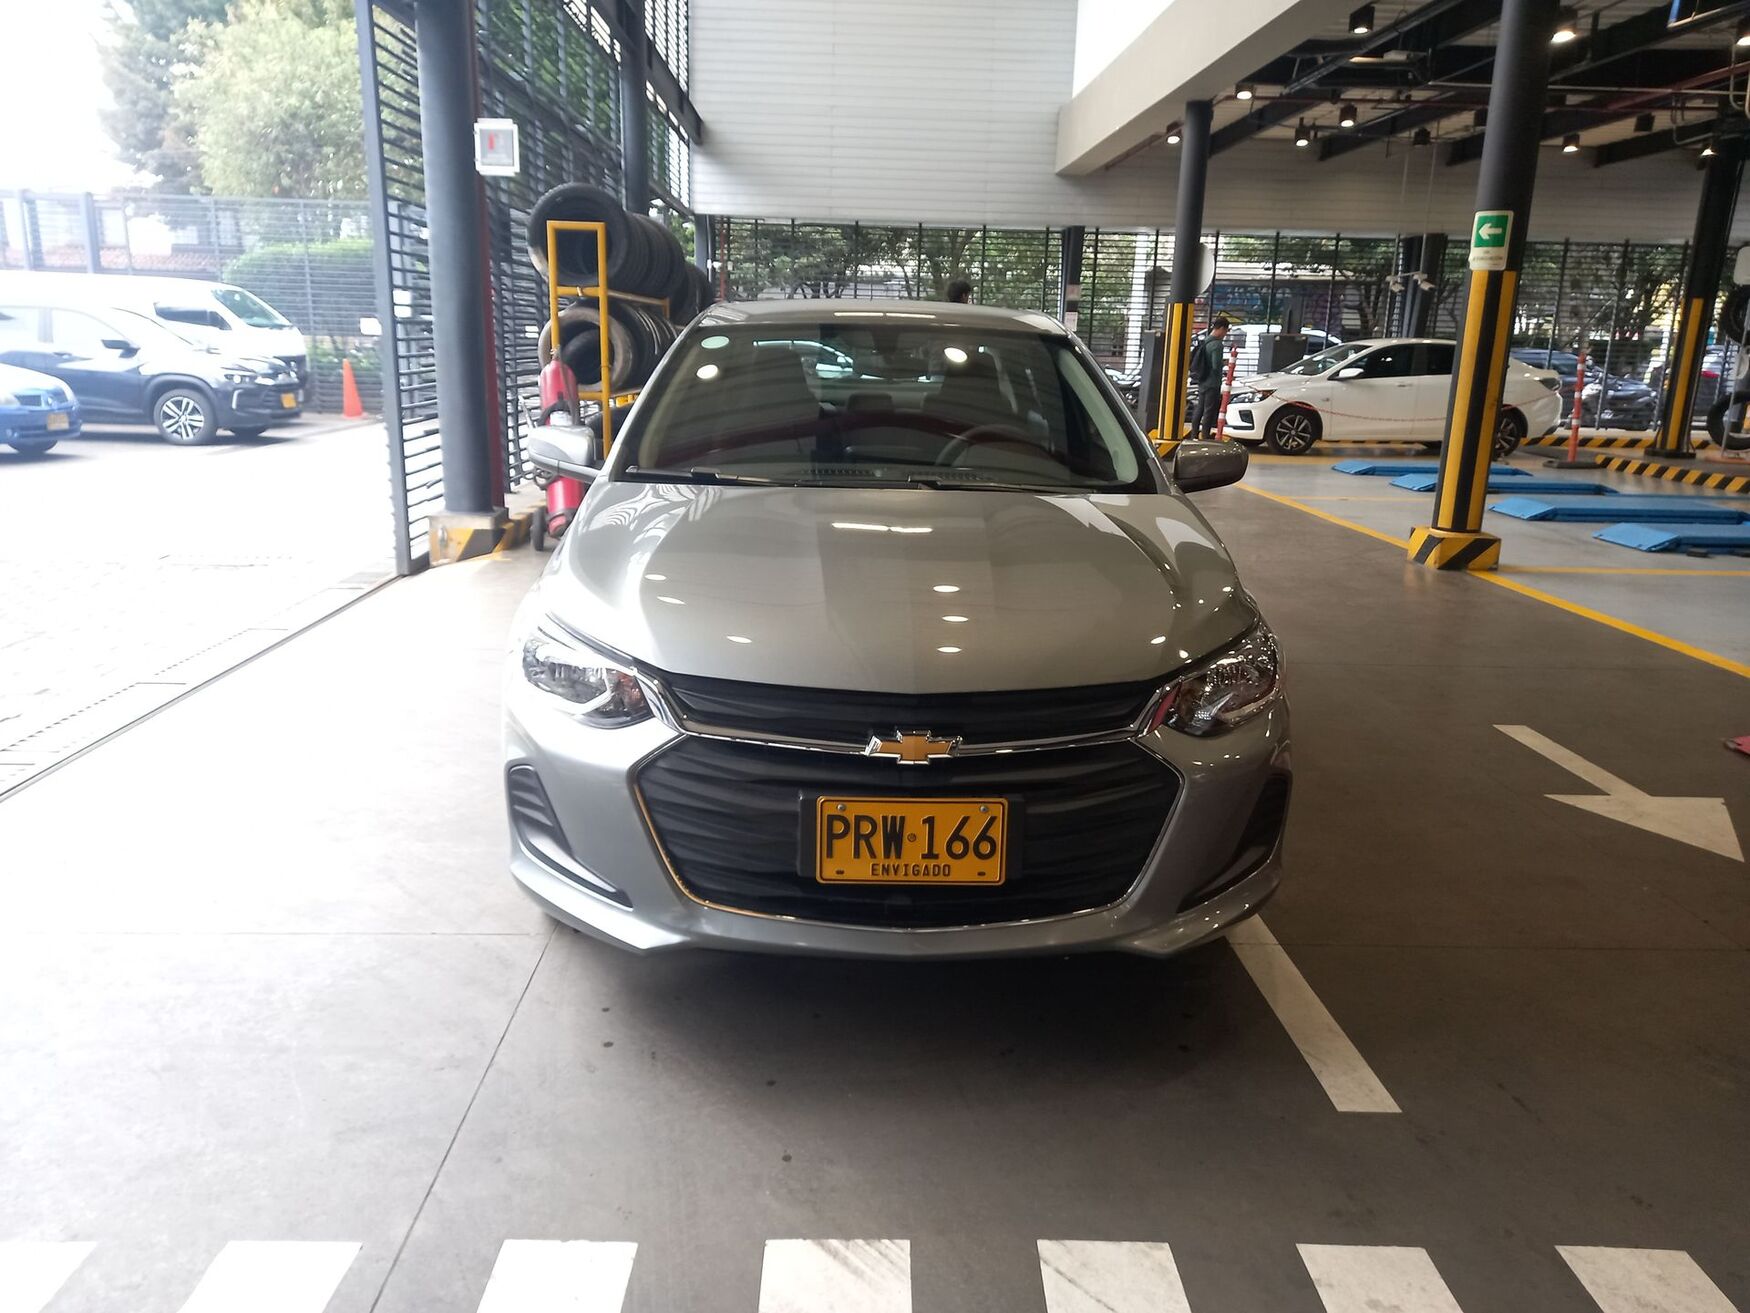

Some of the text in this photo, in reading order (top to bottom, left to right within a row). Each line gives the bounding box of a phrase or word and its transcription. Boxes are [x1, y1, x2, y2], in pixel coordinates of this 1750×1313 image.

[826, 814, 997, 860] PRW 166
[870, 863, 951, 877] ENVIGADO
